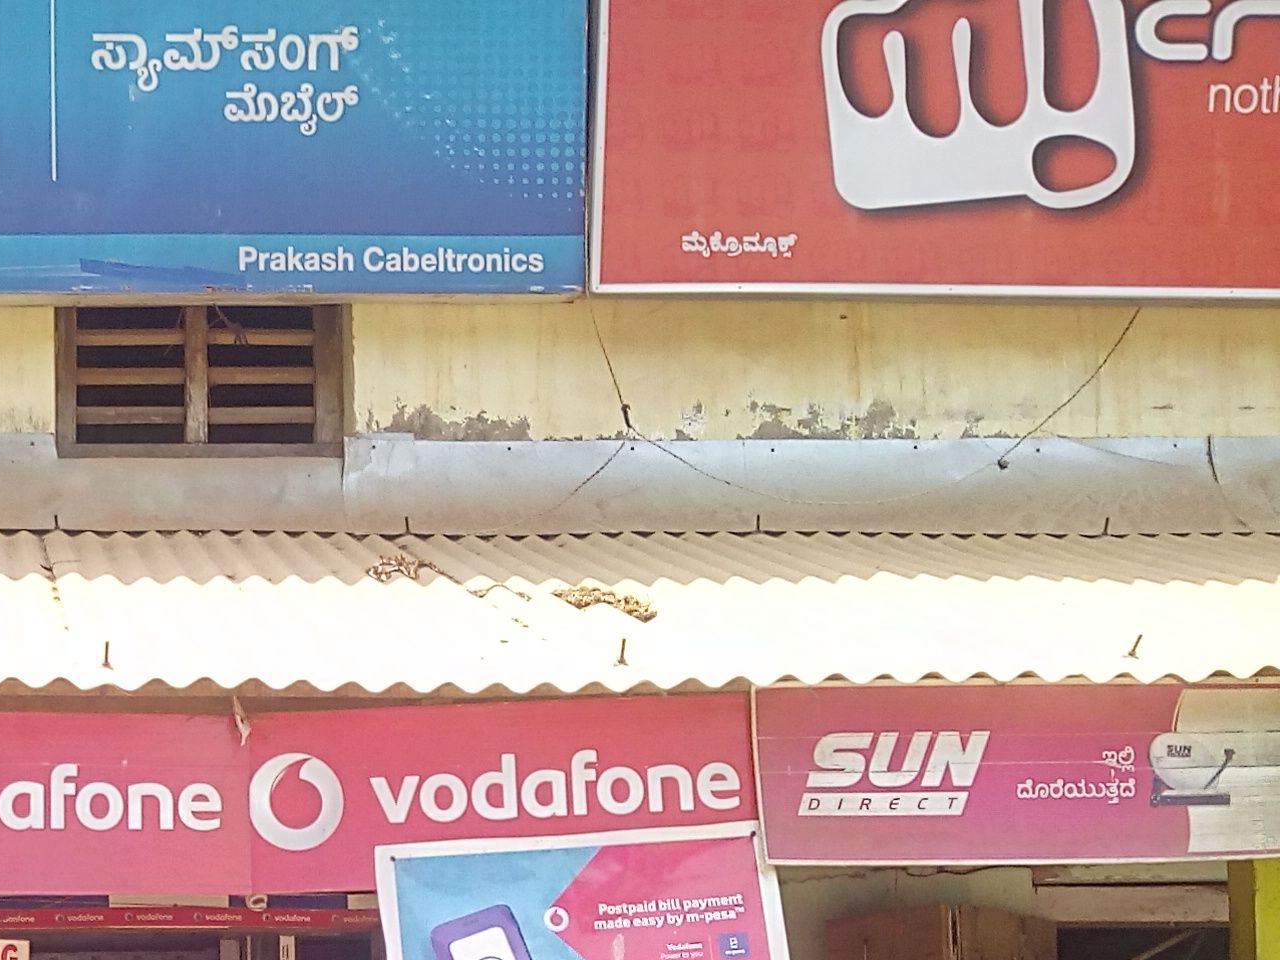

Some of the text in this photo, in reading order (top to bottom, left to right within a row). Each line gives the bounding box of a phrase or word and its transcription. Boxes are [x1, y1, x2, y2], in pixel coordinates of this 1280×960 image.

[238, 246, 543, 273] Prakash Cabeltronics
[805, 731, 990, 787] SUN
[370, 749, 741, 824] vodafone
[807, 797, 960, 812] DIRECT
[598, 894, 744, 915] Postpaid bill payment
[594, 918, 631, 930] made
[633, 916, 665, 929] easy
[666, 913, 684, 927] by
